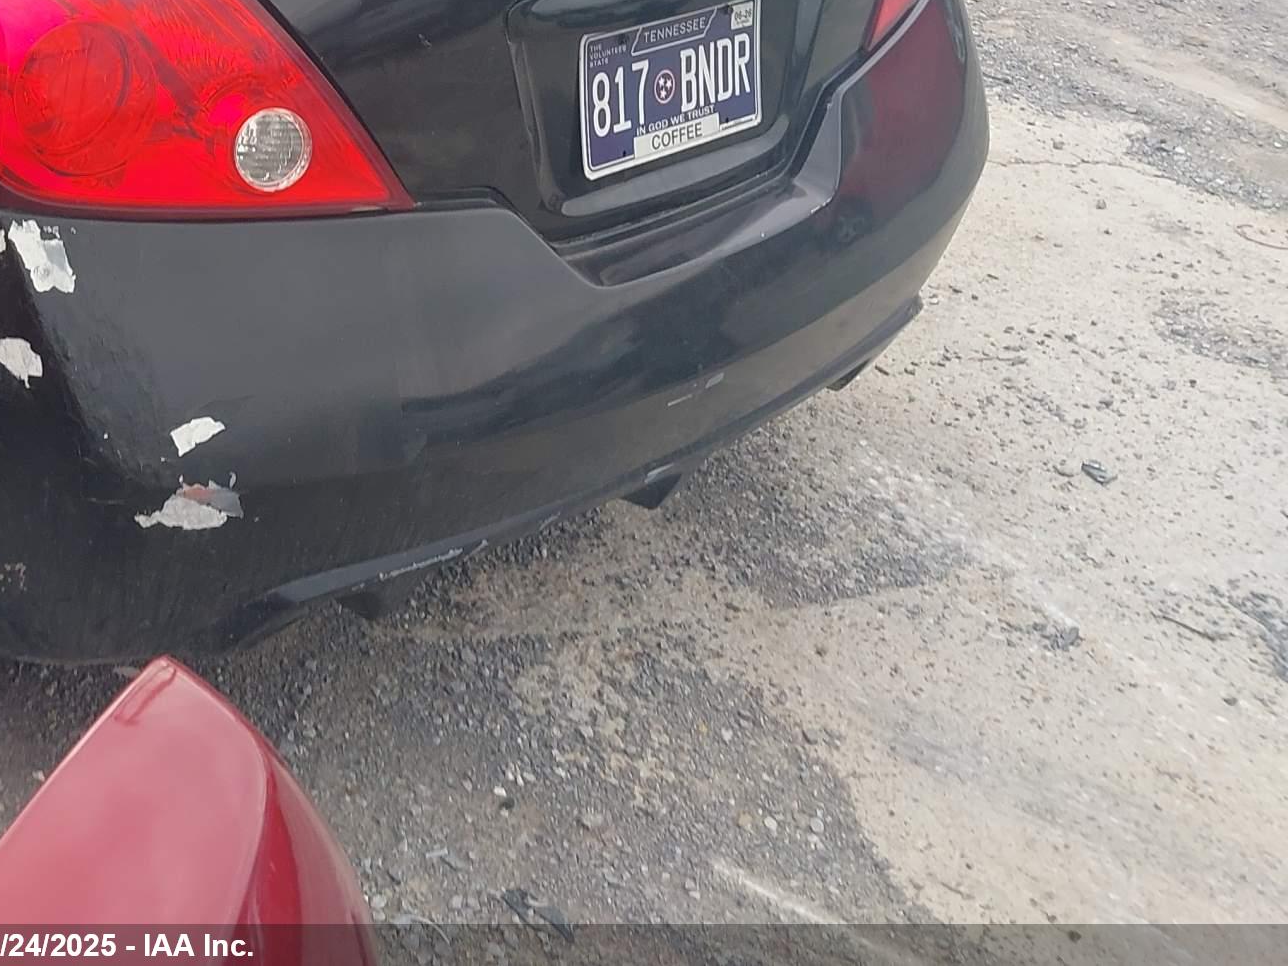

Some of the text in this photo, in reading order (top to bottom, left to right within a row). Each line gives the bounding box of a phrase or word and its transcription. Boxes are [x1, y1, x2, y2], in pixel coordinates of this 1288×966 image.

[643, 16, 706, 43] TENNESSEE
[592, 33, 751, 138] 817 BNDR
[636, 104, 715, 136] IN GOD WE TRUST
[651, 121, 703, 151] COFFEE
